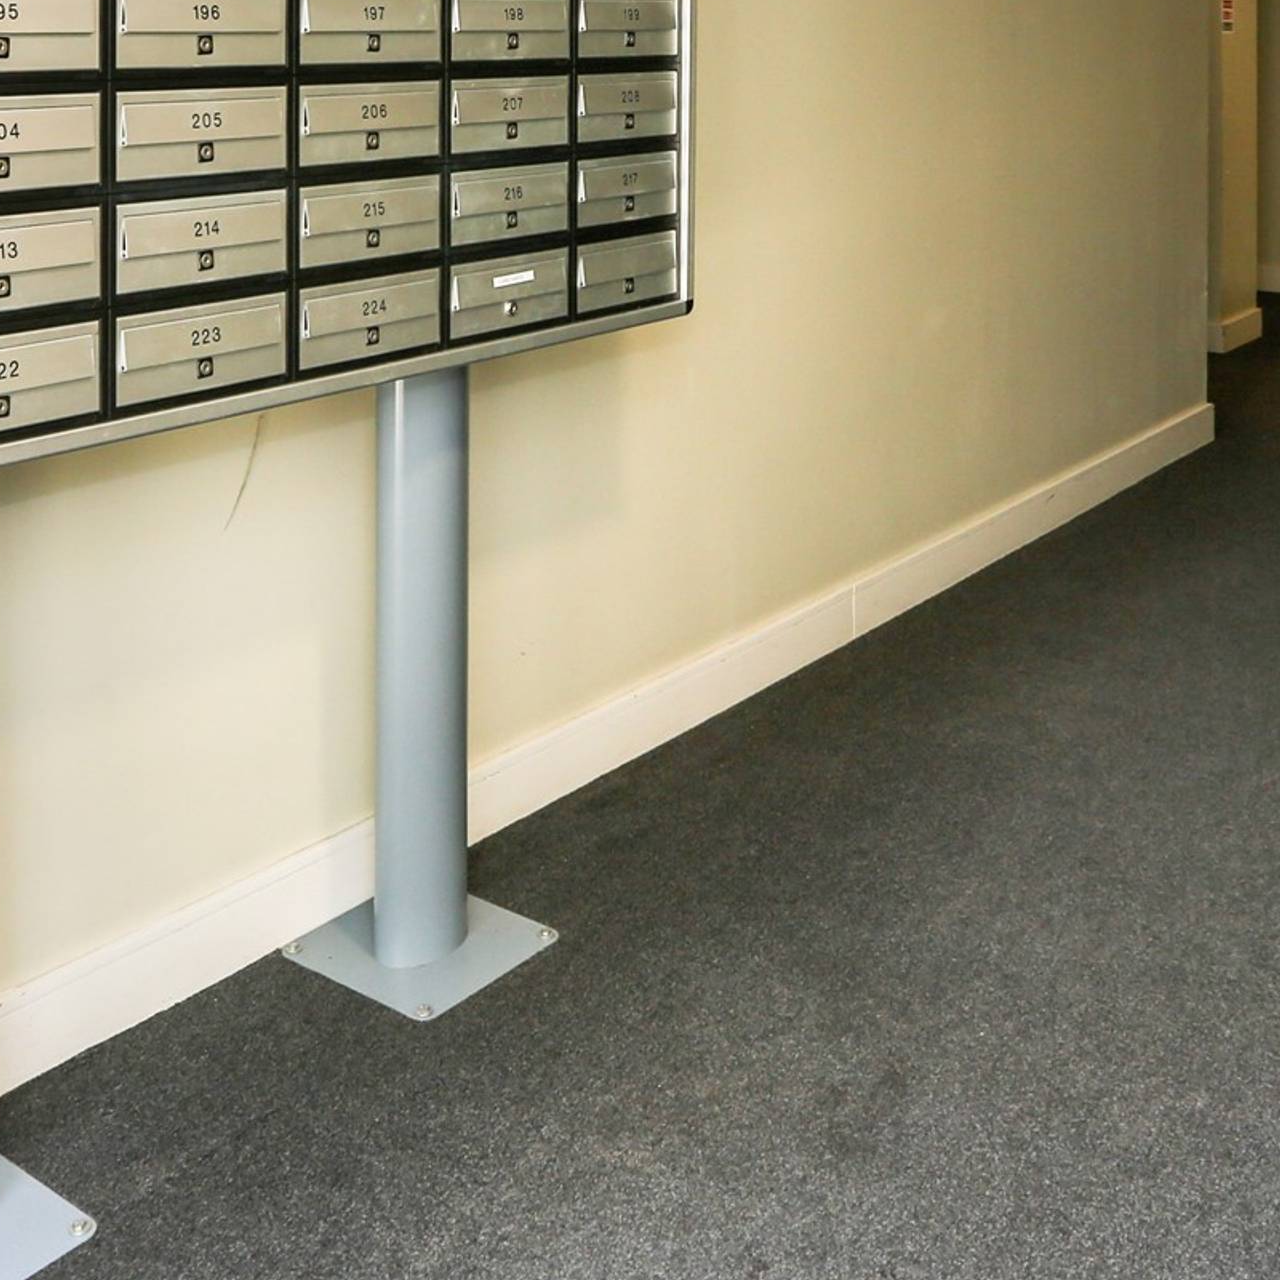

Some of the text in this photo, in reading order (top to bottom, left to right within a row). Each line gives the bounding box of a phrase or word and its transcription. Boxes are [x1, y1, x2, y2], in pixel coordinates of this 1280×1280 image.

[192, 4, 221, 21] 196
[363, 6, 386, 21] 197
[503, 7, 525, 21] 198
[361, 103, 388, 120] 206
[502, 96, 524, 112] 207
[191, 111, 223, 130] 205
[503, 185, 524, 201] 216
[363, 201, 386, 218] 215
[193, 220, 220, 238] 214
[361, 298, 387, 317] 224
[191, 326, 222, 347] 223
